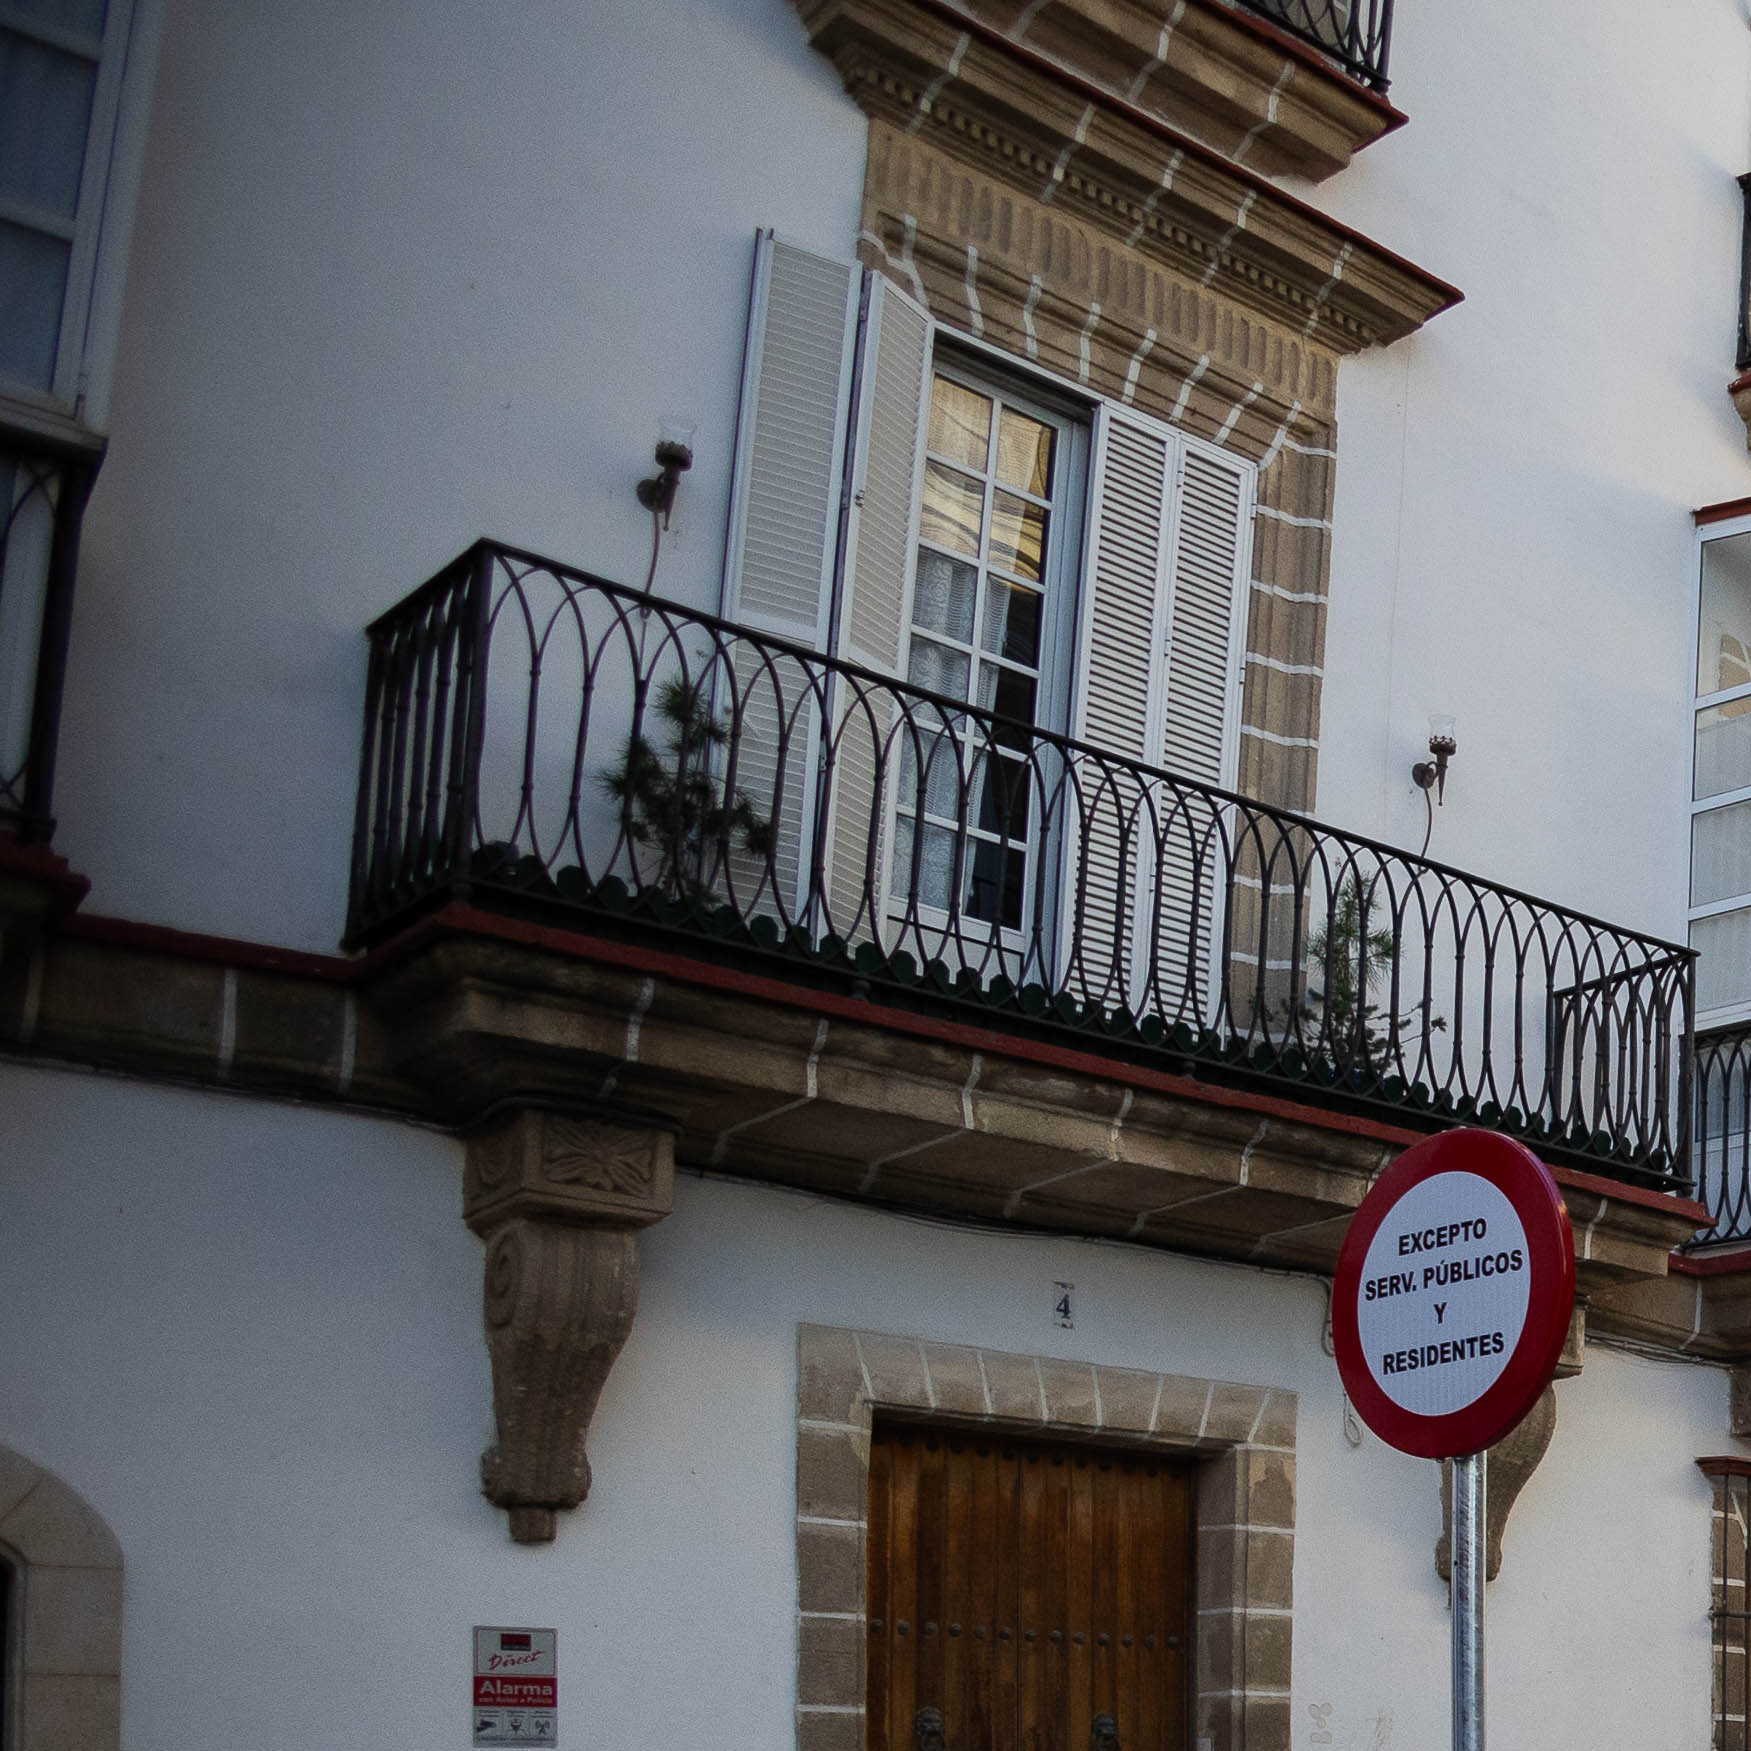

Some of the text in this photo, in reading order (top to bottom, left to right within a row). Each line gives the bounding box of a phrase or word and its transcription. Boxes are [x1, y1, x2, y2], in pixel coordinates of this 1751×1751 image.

[1398, 1218, 1487, 1256] EXCEPTO
[1365, 1249, 1524, 1301] SERV. PÚBLICOS
[1056, 1294, 1071, 1319] 4
[1433, 1302, 1447, 1324] Y
[1382, 1331, 1505, 1375] RESIDENTES
[480, 1680, 553, 1696] Alarma
